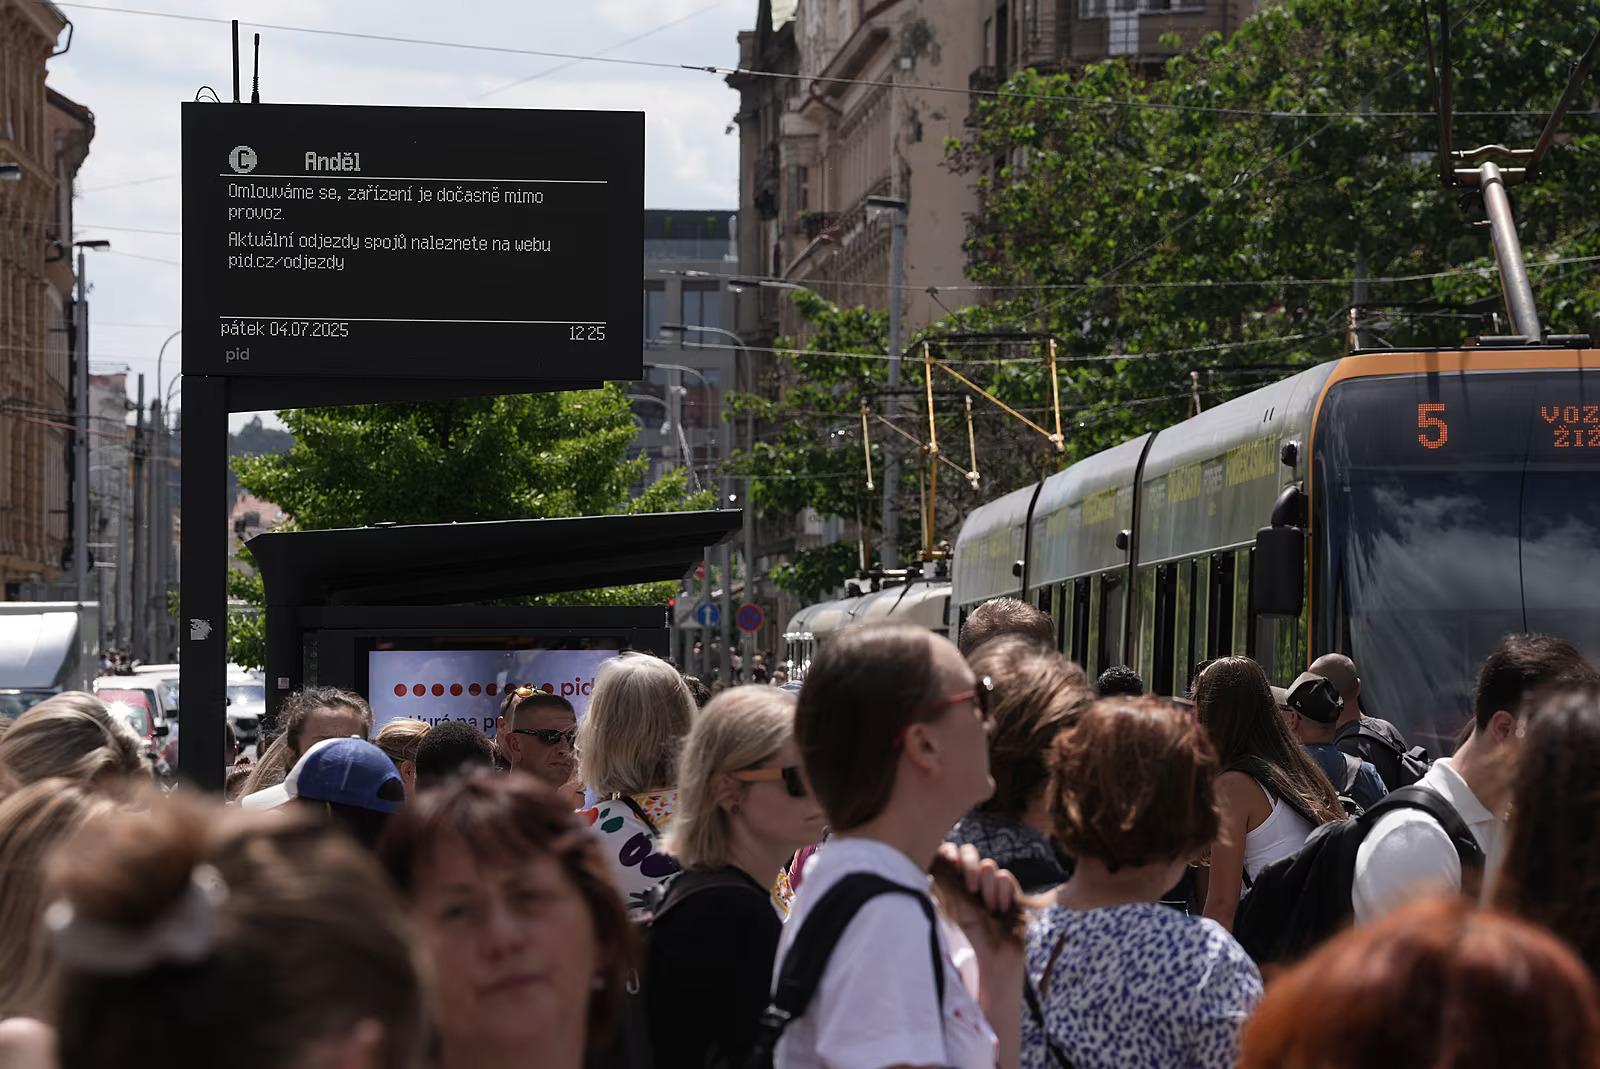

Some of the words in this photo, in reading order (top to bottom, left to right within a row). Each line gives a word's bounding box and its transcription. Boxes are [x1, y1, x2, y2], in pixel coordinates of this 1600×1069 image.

[306, 152, 360, 171] Anděl
[229, 183, 313, 199] Omlouváme
[319, 188, 341, 201] se,
[348, 185, 412, 201] zařízení
[418, 187, 432, 202] je
[437, 186, 499, 202] dočasně
[505, 189, 543, 203] mimo
[229, 208, 284, 220] provoz.
[229, 231, 294, 247] Aktuální
[299, 234, 359, 250] odjezdy
[365, 234, 406, 250] spojů
[412, 236, 487, 250] naleznete
[493, 240, 510, 251] na
[515, 237, 550, 251] webu
[229, 253, 344, 270] pid.cz/odjezdy
[221, 320, 264, 336] pátek
[270, 322, 348, 337] 04.07.2025
[226, 347, 249, 363] pid
[1542, 406, 1598, 423] VOZ
[1419, 404, 1448, 448] 5
